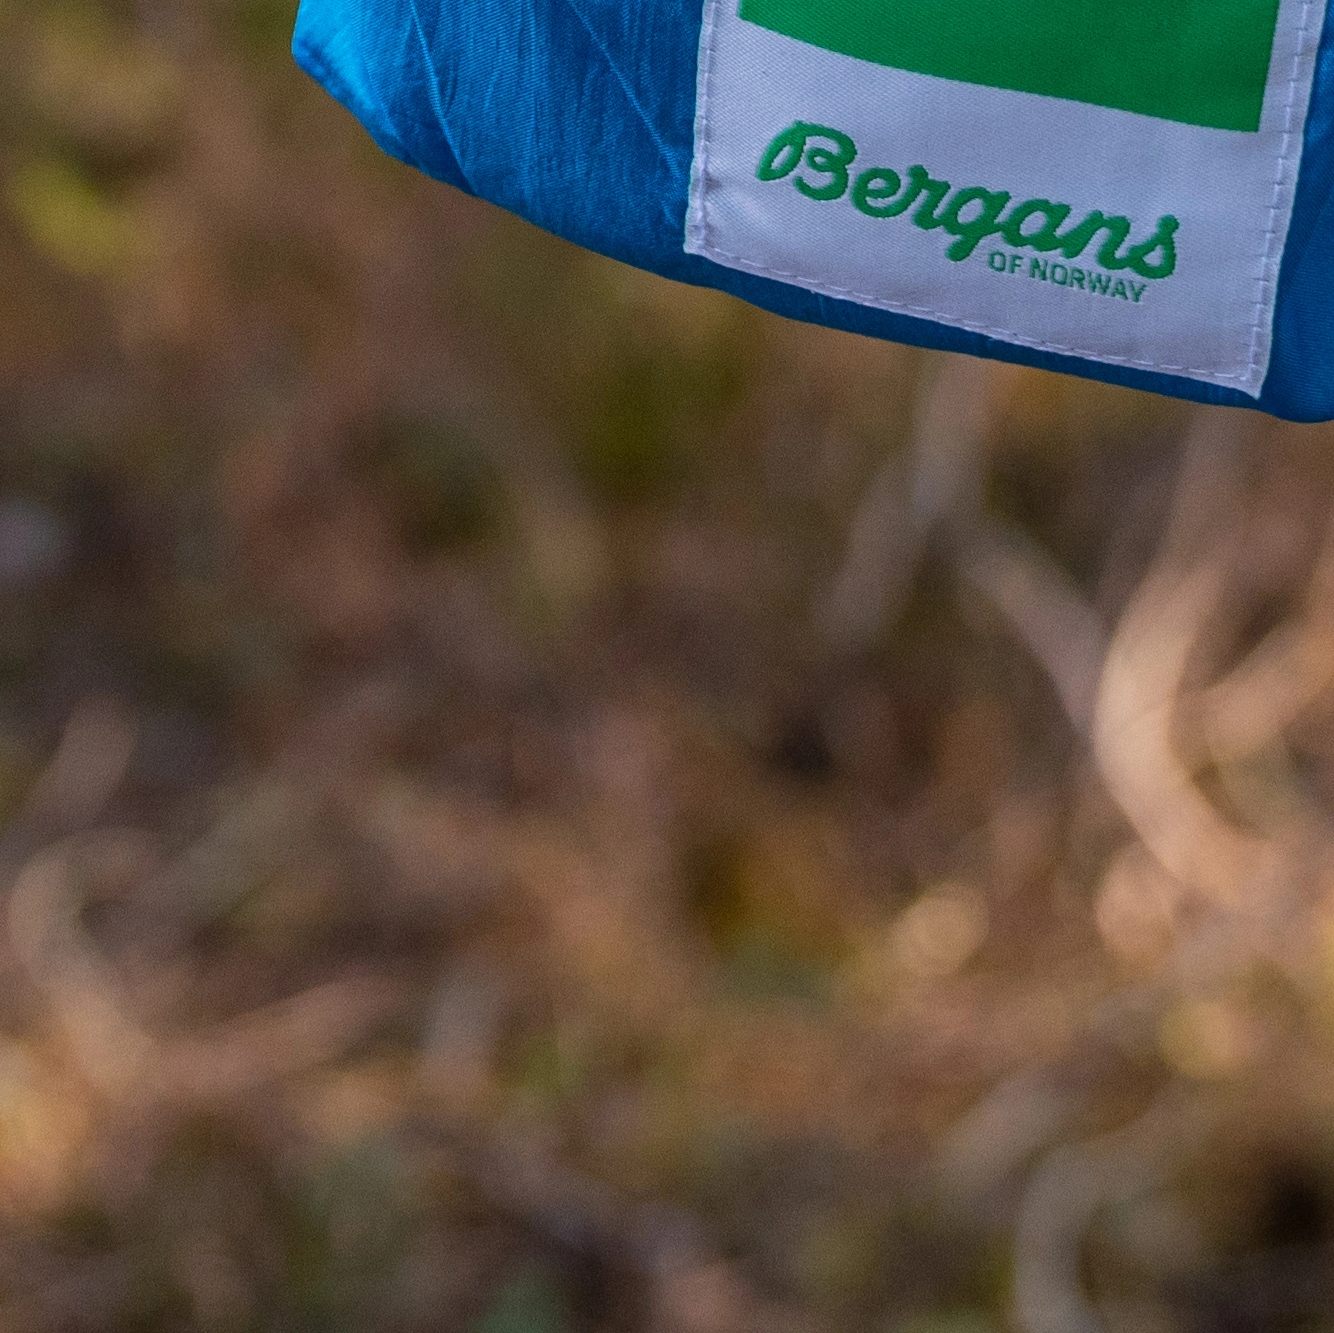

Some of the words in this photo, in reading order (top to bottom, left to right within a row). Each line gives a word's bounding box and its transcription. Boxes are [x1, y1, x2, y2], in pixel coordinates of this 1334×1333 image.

[757, 119, 1181, 280] Bergans
[989, 250, 1022, 274] OF
[1029, 259, 1147, 304] NORWAY
